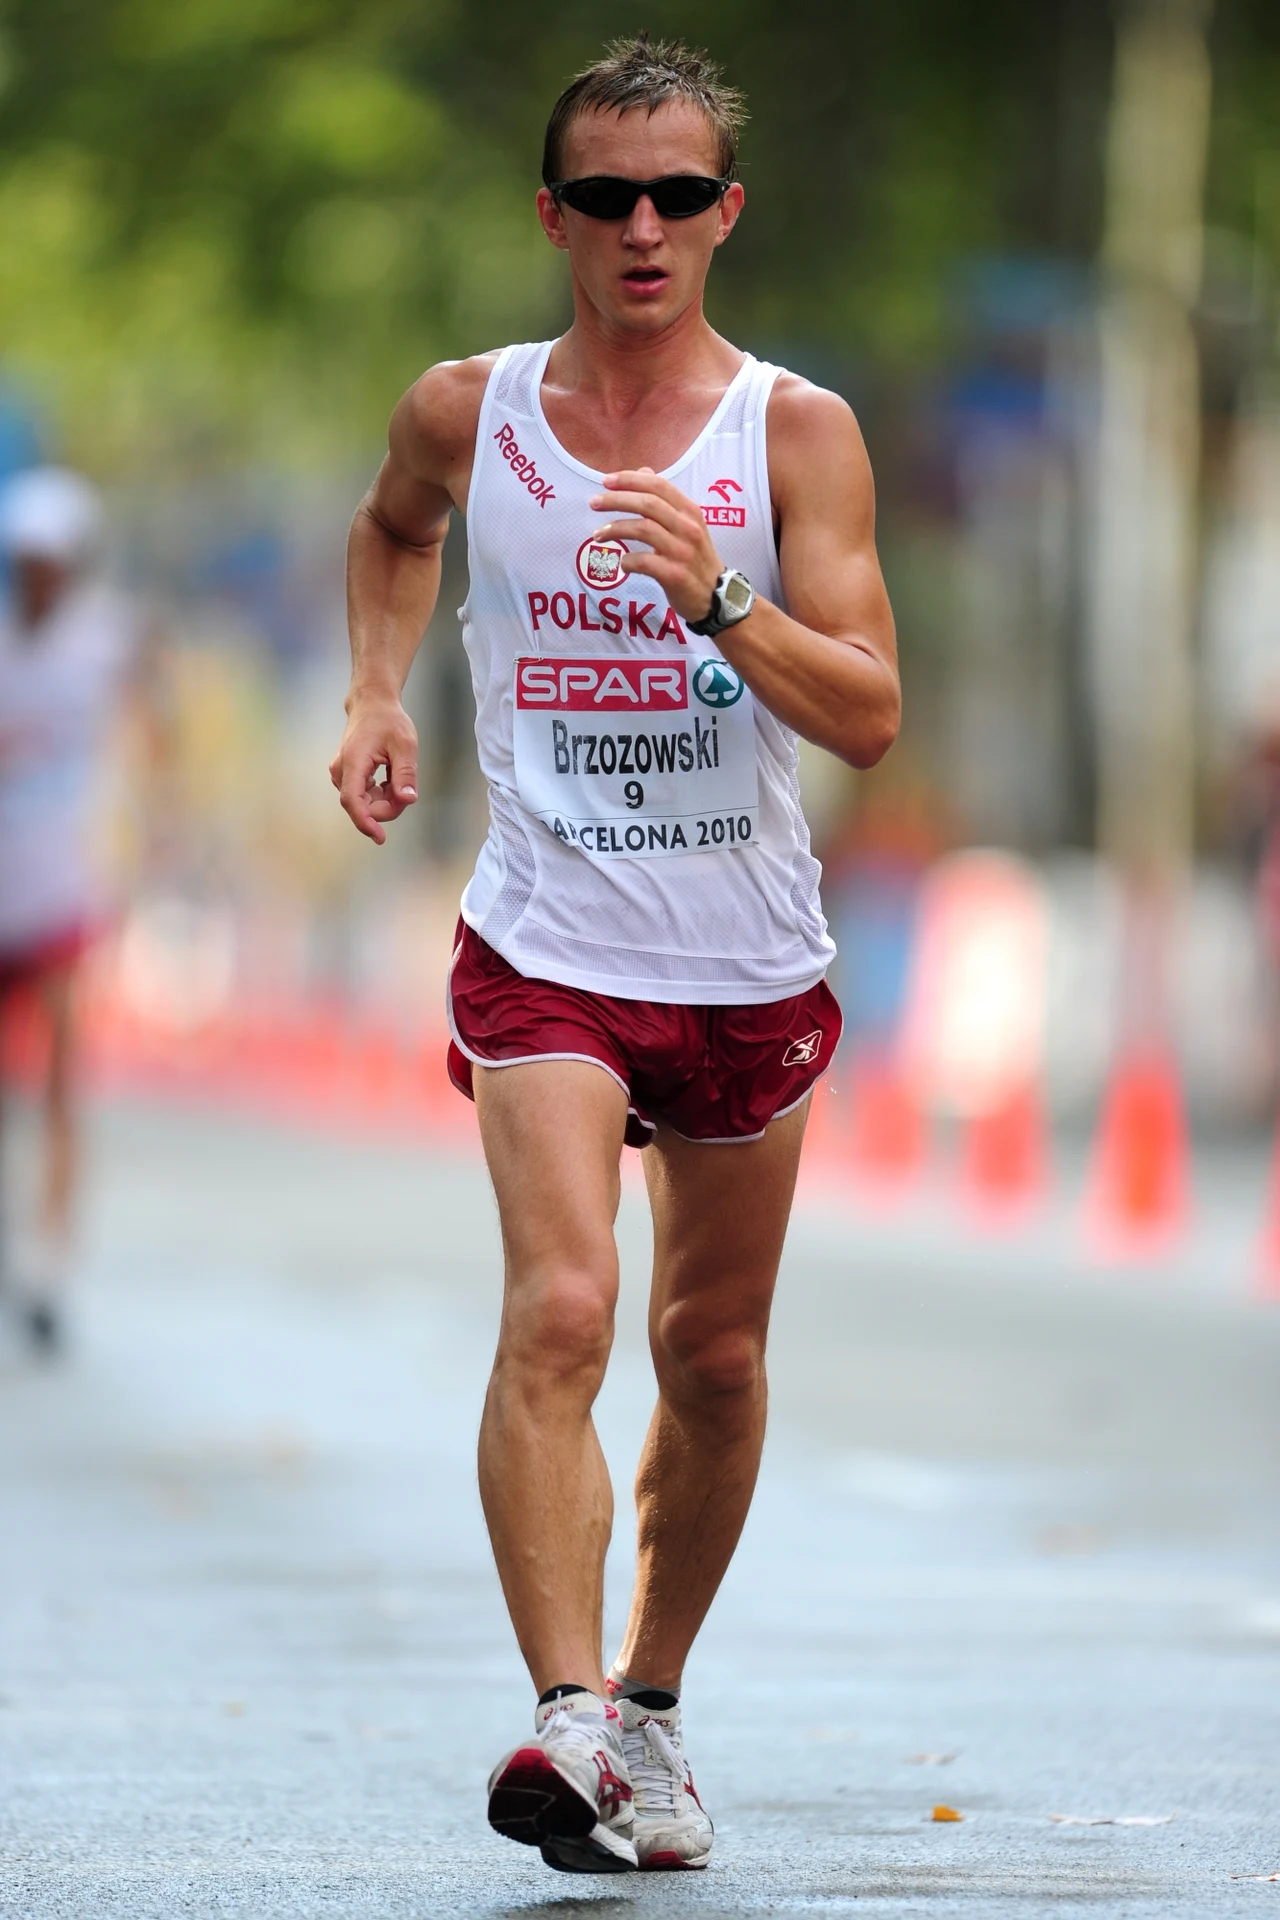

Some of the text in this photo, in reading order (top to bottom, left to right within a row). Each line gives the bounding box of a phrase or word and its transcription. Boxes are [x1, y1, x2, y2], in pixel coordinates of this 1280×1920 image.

[494, 423, 556, 508] Reebok
[701, 508, 742, 525] RLEN
[528, 591, 687, 644] POLSKA
[521, 666, 682, 704] SPAR
[552, 715, 719, 775] Brzozowski
[624, 781, 644, 809] 9
[541, 815, 751, 852] ARCELONA 2010
